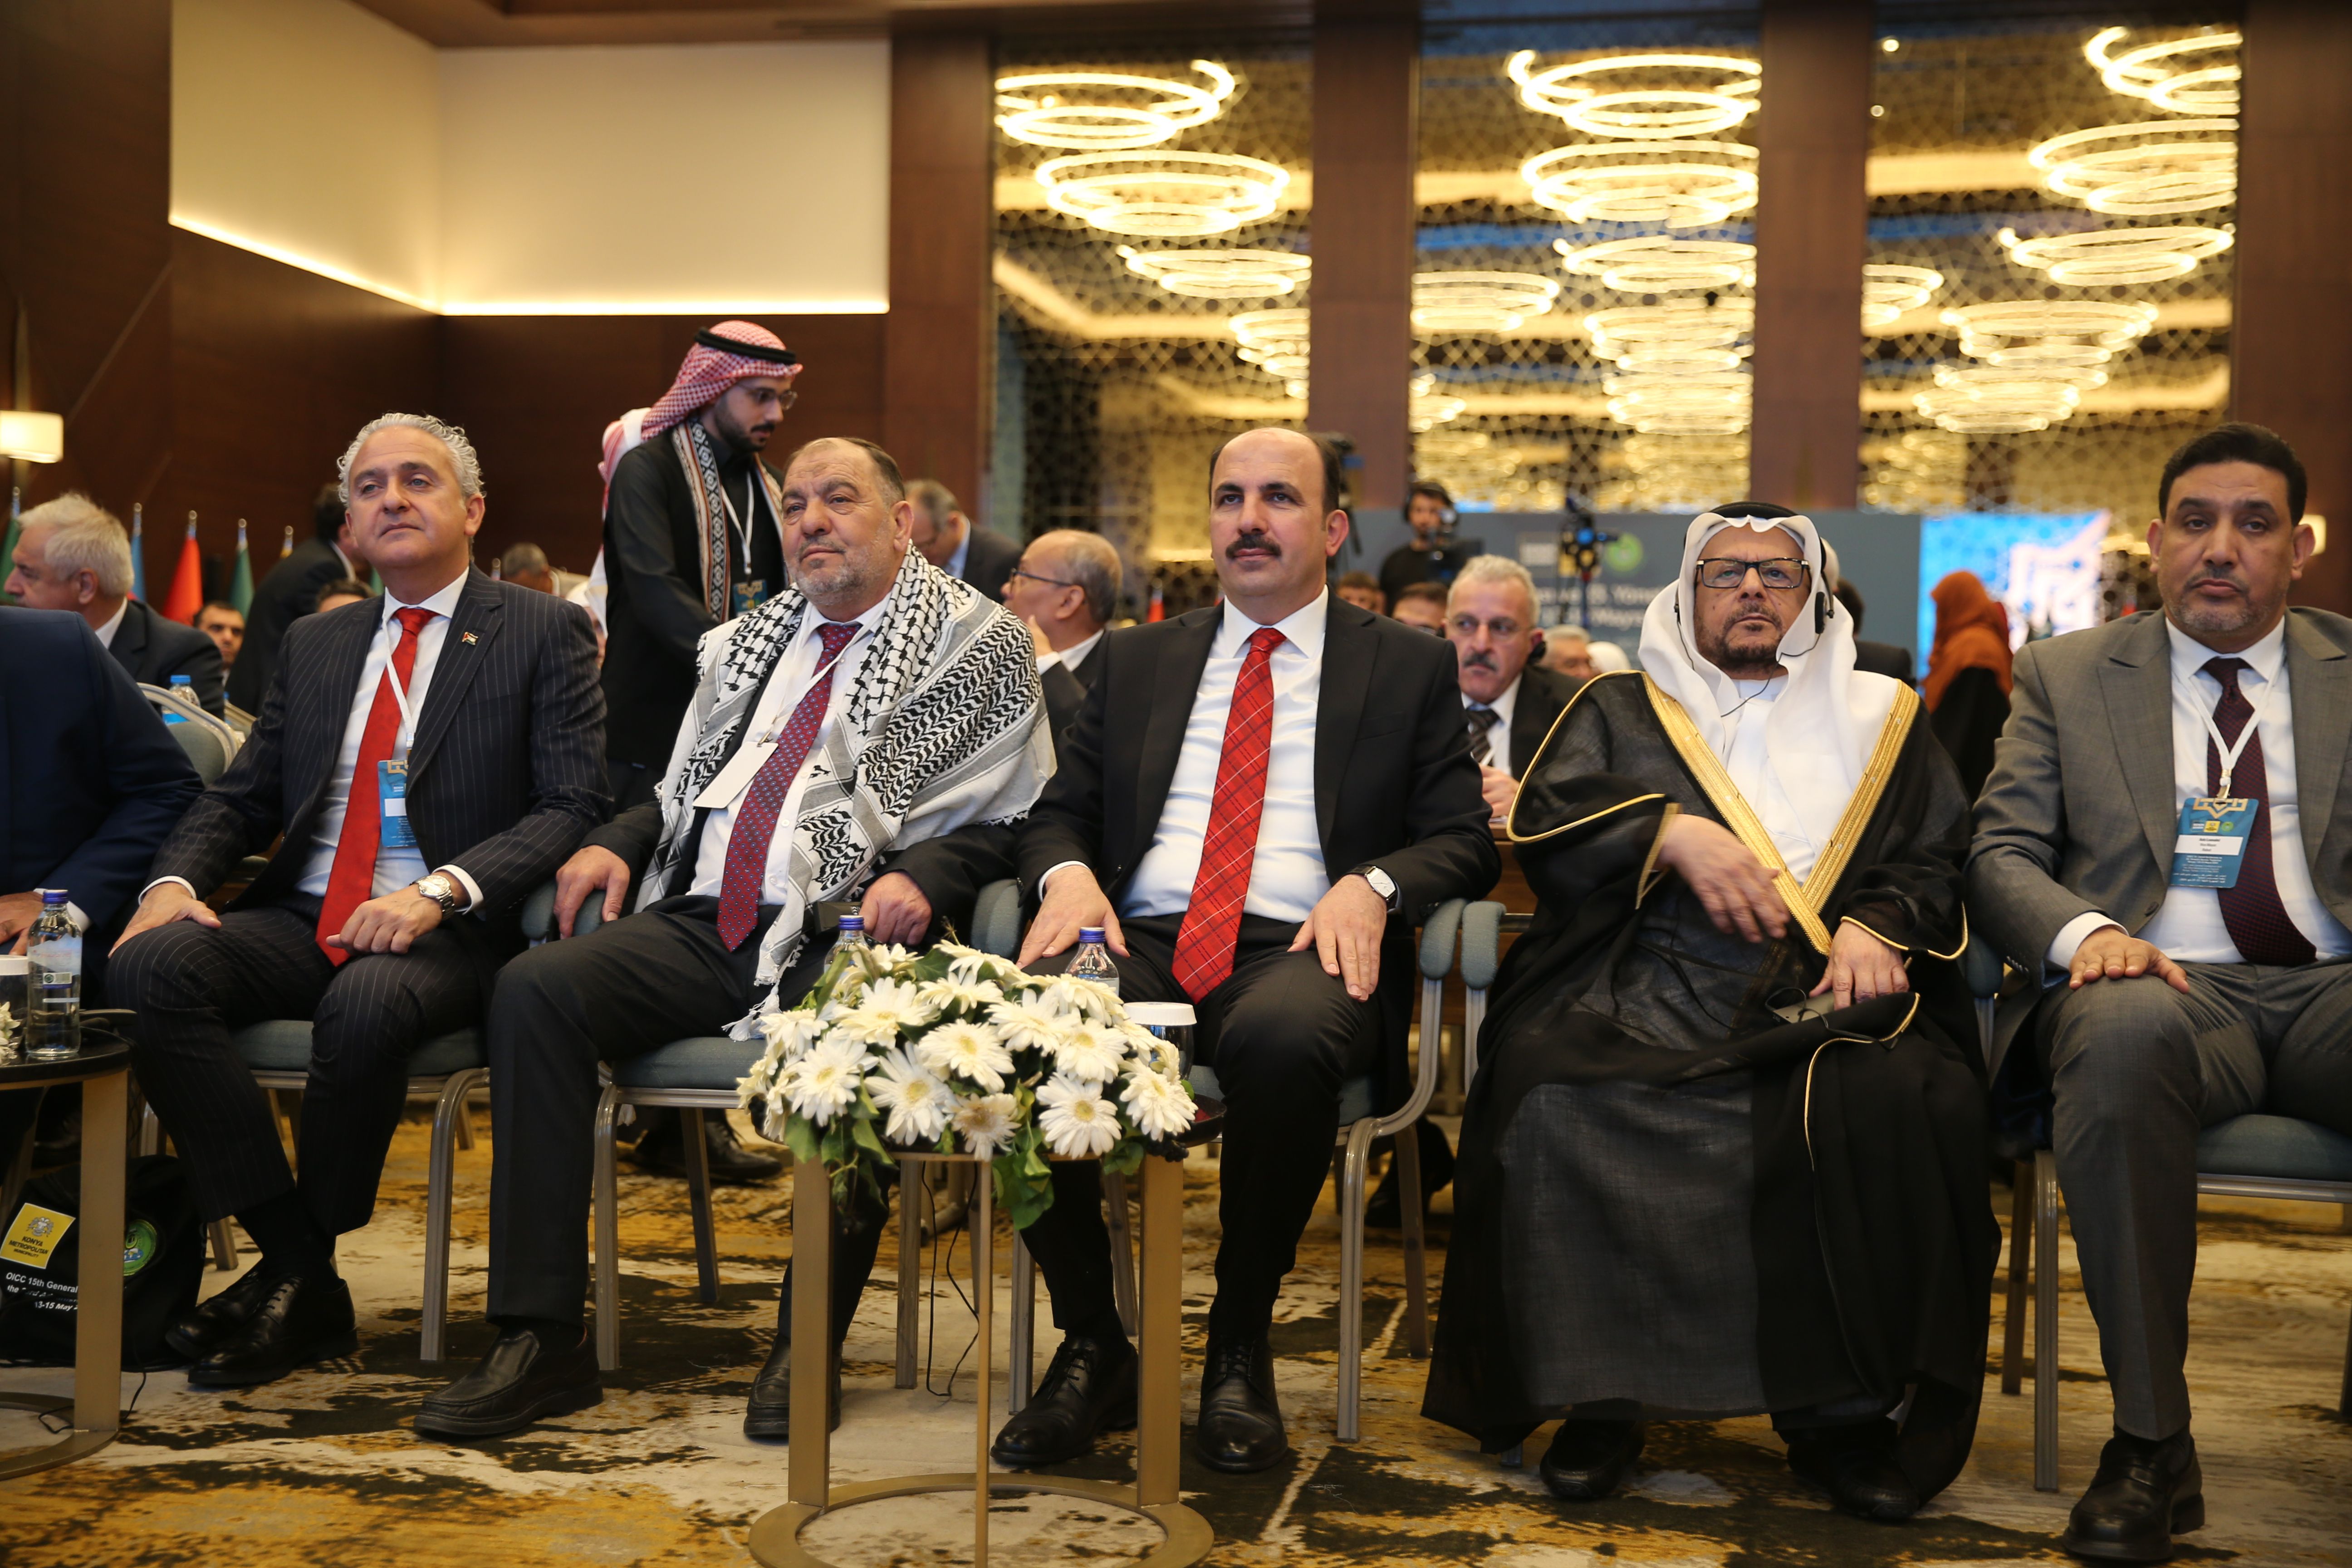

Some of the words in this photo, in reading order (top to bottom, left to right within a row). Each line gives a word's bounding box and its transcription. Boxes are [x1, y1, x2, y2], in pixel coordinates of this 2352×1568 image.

[9, 1240, 49, 1254] METROPOLITAN
[22, 1236, 43, 1246] KONYA
[14, 1249, 39, 1258] MUNICIPALITY
[6, 1272, 26, 1283] OICC
[28, 1277, 44, 1287] 15th
[46, 1281, 78, 1293] General
